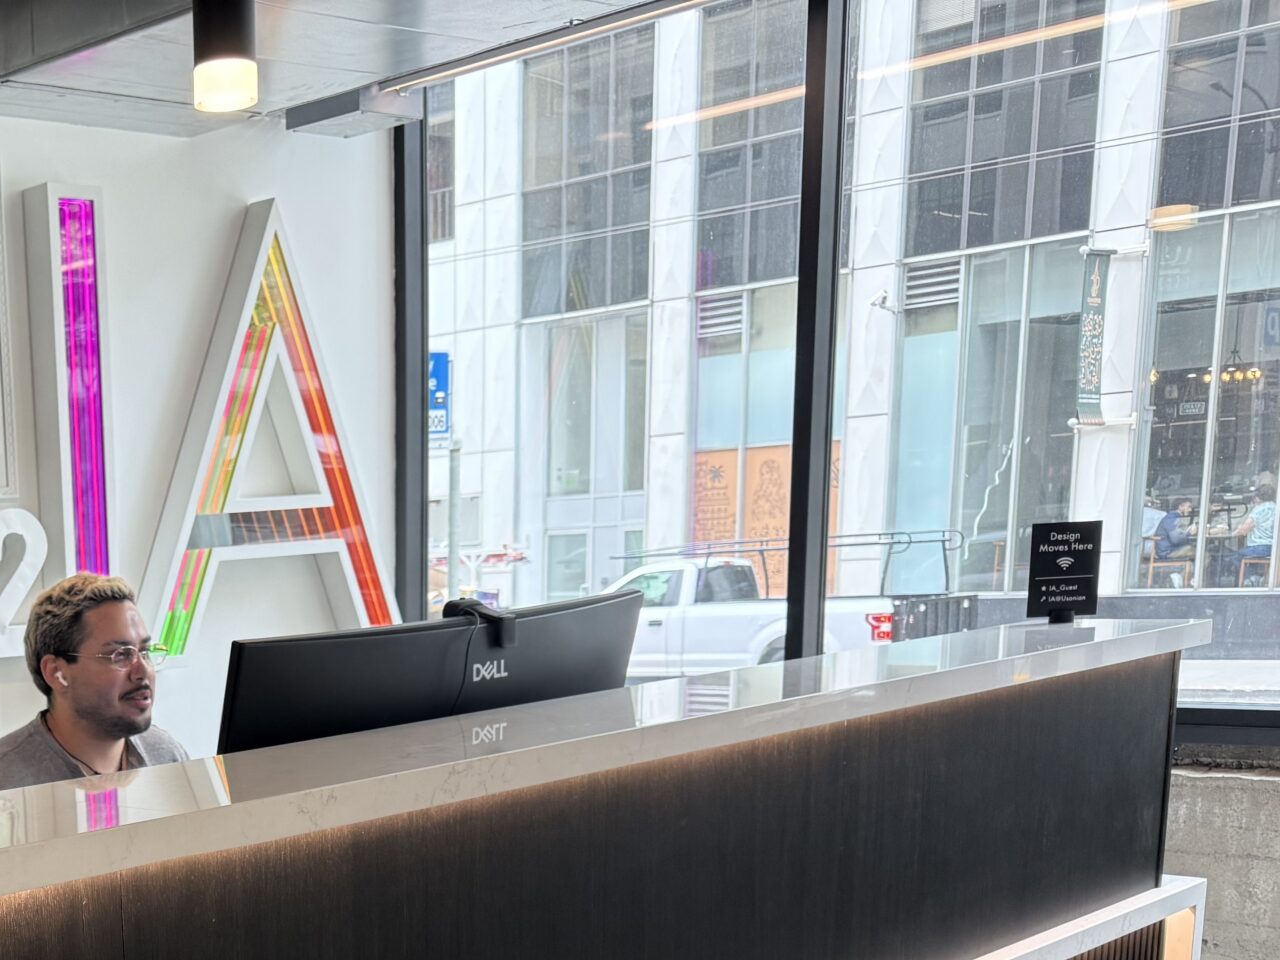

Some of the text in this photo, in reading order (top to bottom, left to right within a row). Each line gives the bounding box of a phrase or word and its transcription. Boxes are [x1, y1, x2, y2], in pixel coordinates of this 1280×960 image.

[1050, 531, 1081, 541] Design
[1039, 542, 1093, 552] Moves Here
[472, 659, 509, 682] DELL
